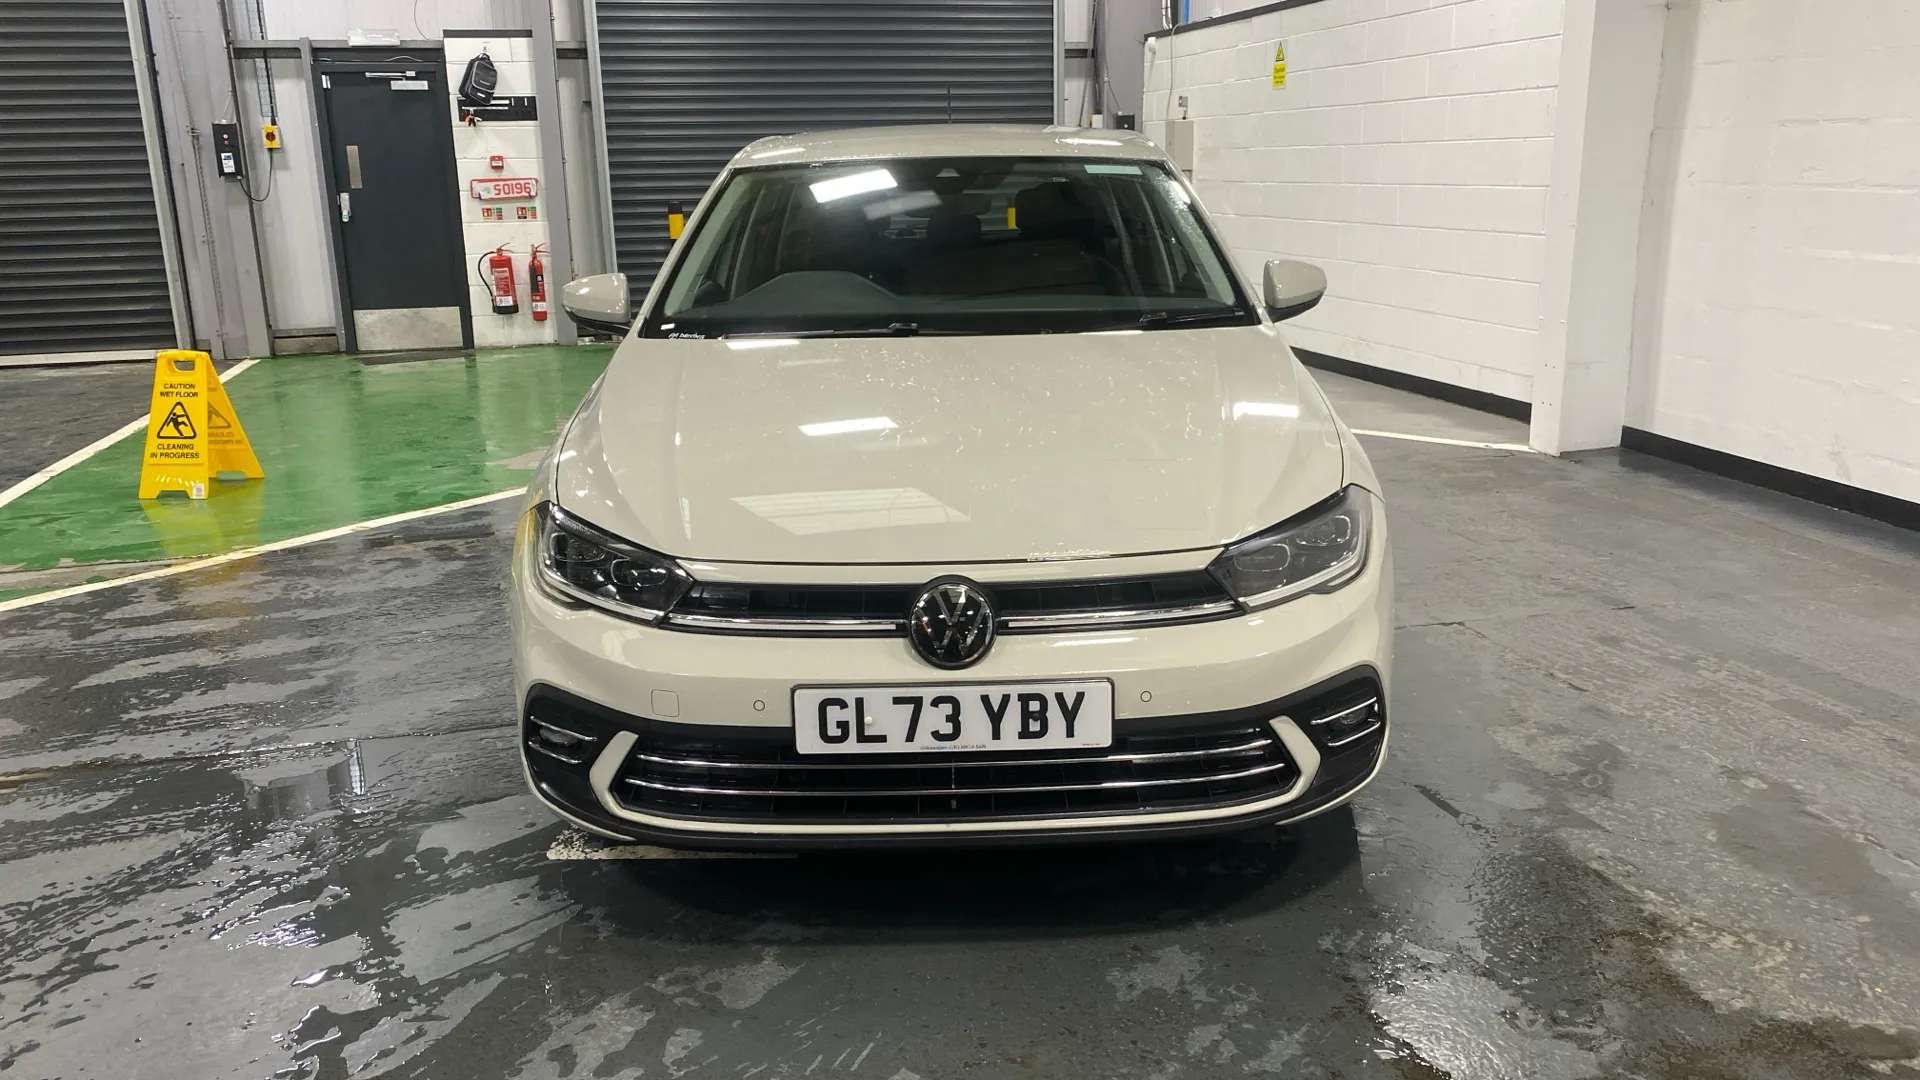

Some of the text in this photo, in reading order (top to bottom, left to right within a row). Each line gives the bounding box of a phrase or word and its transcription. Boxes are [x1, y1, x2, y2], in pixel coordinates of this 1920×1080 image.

[817, 691, 1085, 744] GL 73 YBY
